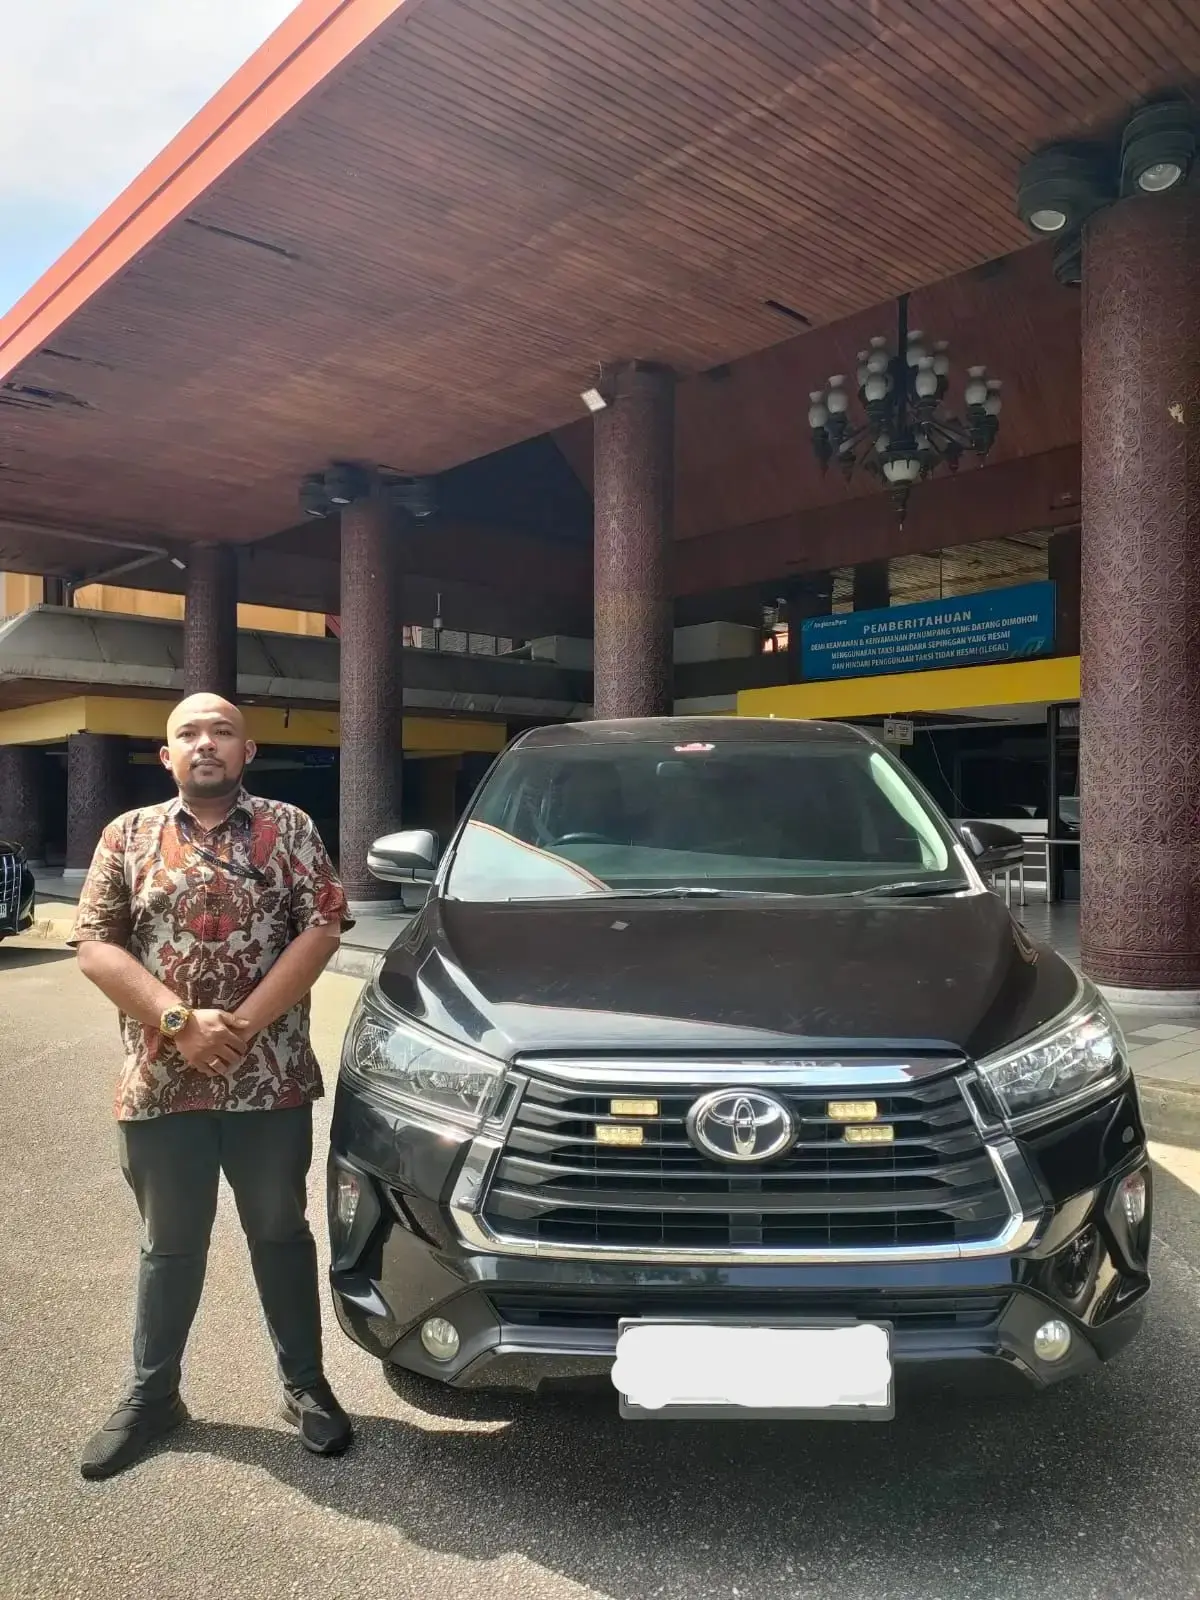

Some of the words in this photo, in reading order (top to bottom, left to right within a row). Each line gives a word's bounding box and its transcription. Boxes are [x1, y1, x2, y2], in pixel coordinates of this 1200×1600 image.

[810, 643, 826, 651] DEMI
[826, 639, 859, 649] KEAMANAN
[865, 634, 908, 645] KENYAMANAN
[908, 629, 951, 641] PENUMPANG
[951, 626, 970, 635] YANG
[971, 620, 1001, 631] DATANG
[1001, 614, 1039, 627] DIMOHON
[863, 610, 972, 634] PEMBERITAHUAN
[831, 647, 877, 659] MENGGUNAKAN
[877, 646, 895, 655] TAKSI
[896, 641, 927, 654] BANDARA
[928, 636, 966, 649] SEPINGGAN
[967, 633, 987, 644] YANG
[987, 630, 1011, 641] RESMI
[832, 661, 845, 671] DAN
[845, 659, 871, 670] HINDARI
[871, 655, 914, 667] PENGGUNAAN
[915, 652, 934, 662] TAKSI
[935, 650, 955, 660] TIDAK
[956, 647, 978, 657] RESMI
